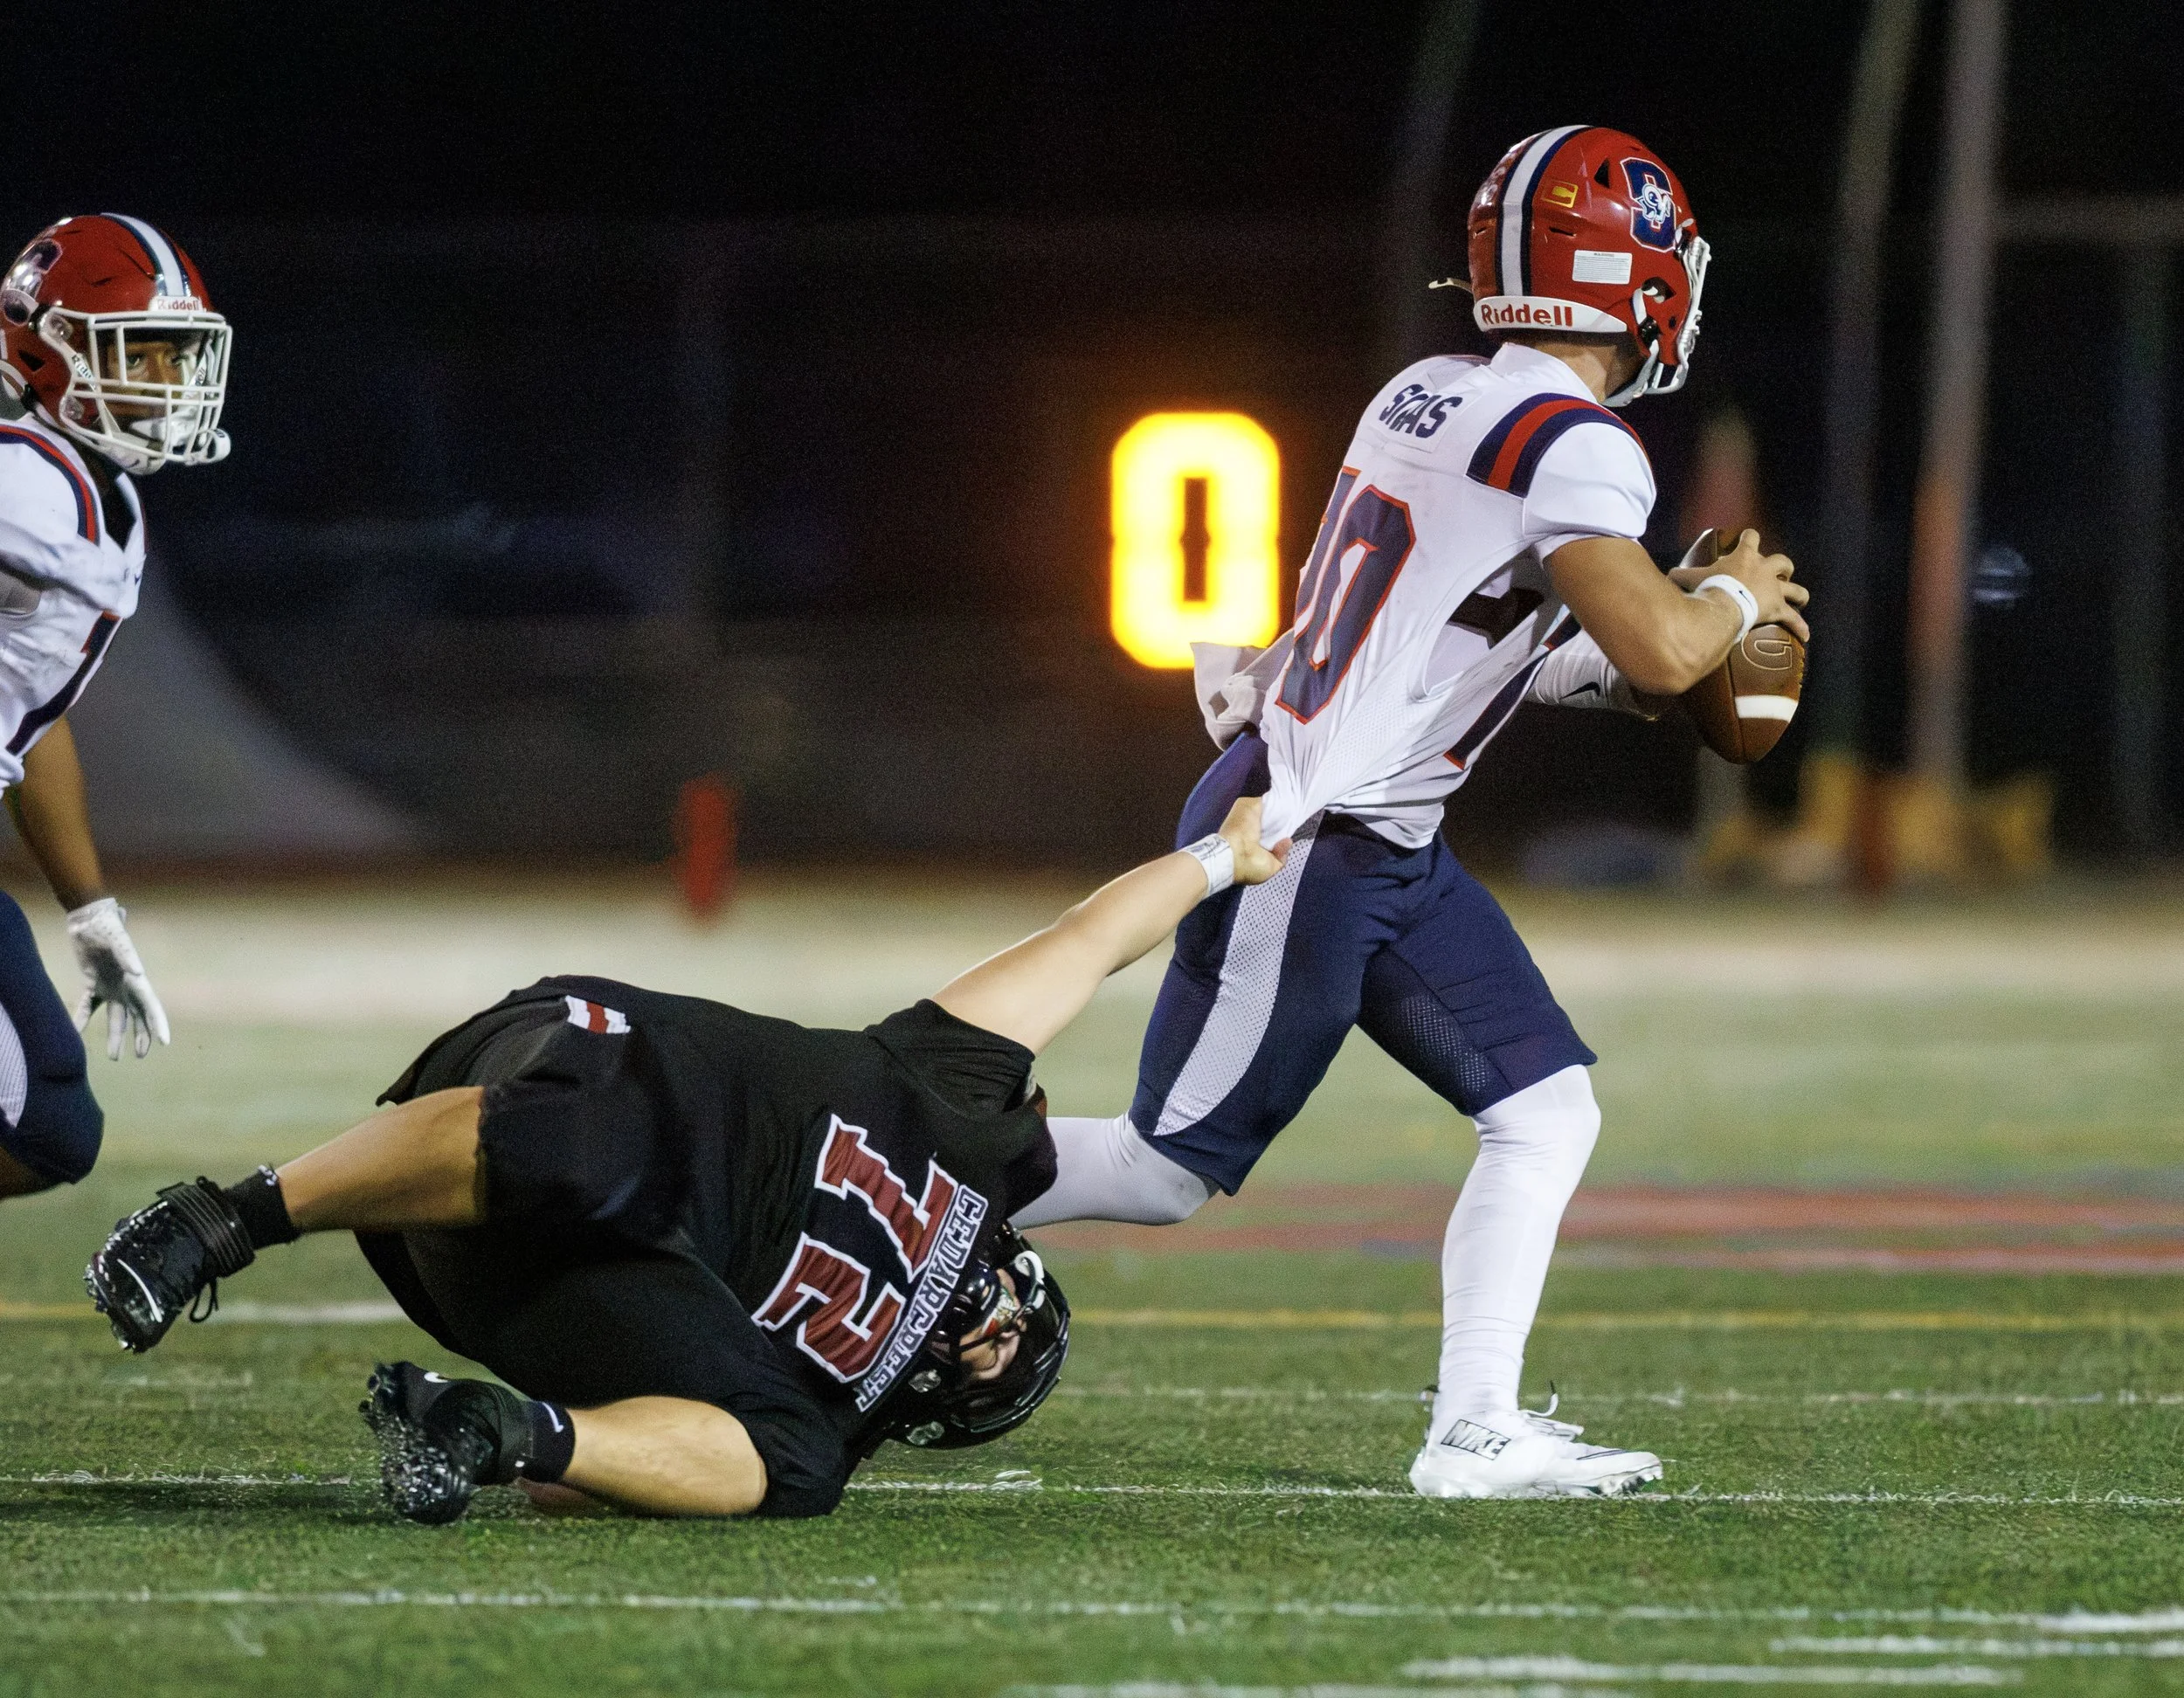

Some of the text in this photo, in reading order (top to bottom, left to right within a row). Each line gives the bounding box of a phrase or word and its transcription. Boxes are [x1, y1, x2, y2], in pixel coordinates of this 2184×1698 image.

[1481, 303, 1572, 328] Riddell
[1110, 411, 1281, 669] 0
[750, 1112, 958, 1384] 72
[855, 1184, 989, 1413] CEDARCREST
[1440, 1418, 1512, 1461] NIKE
